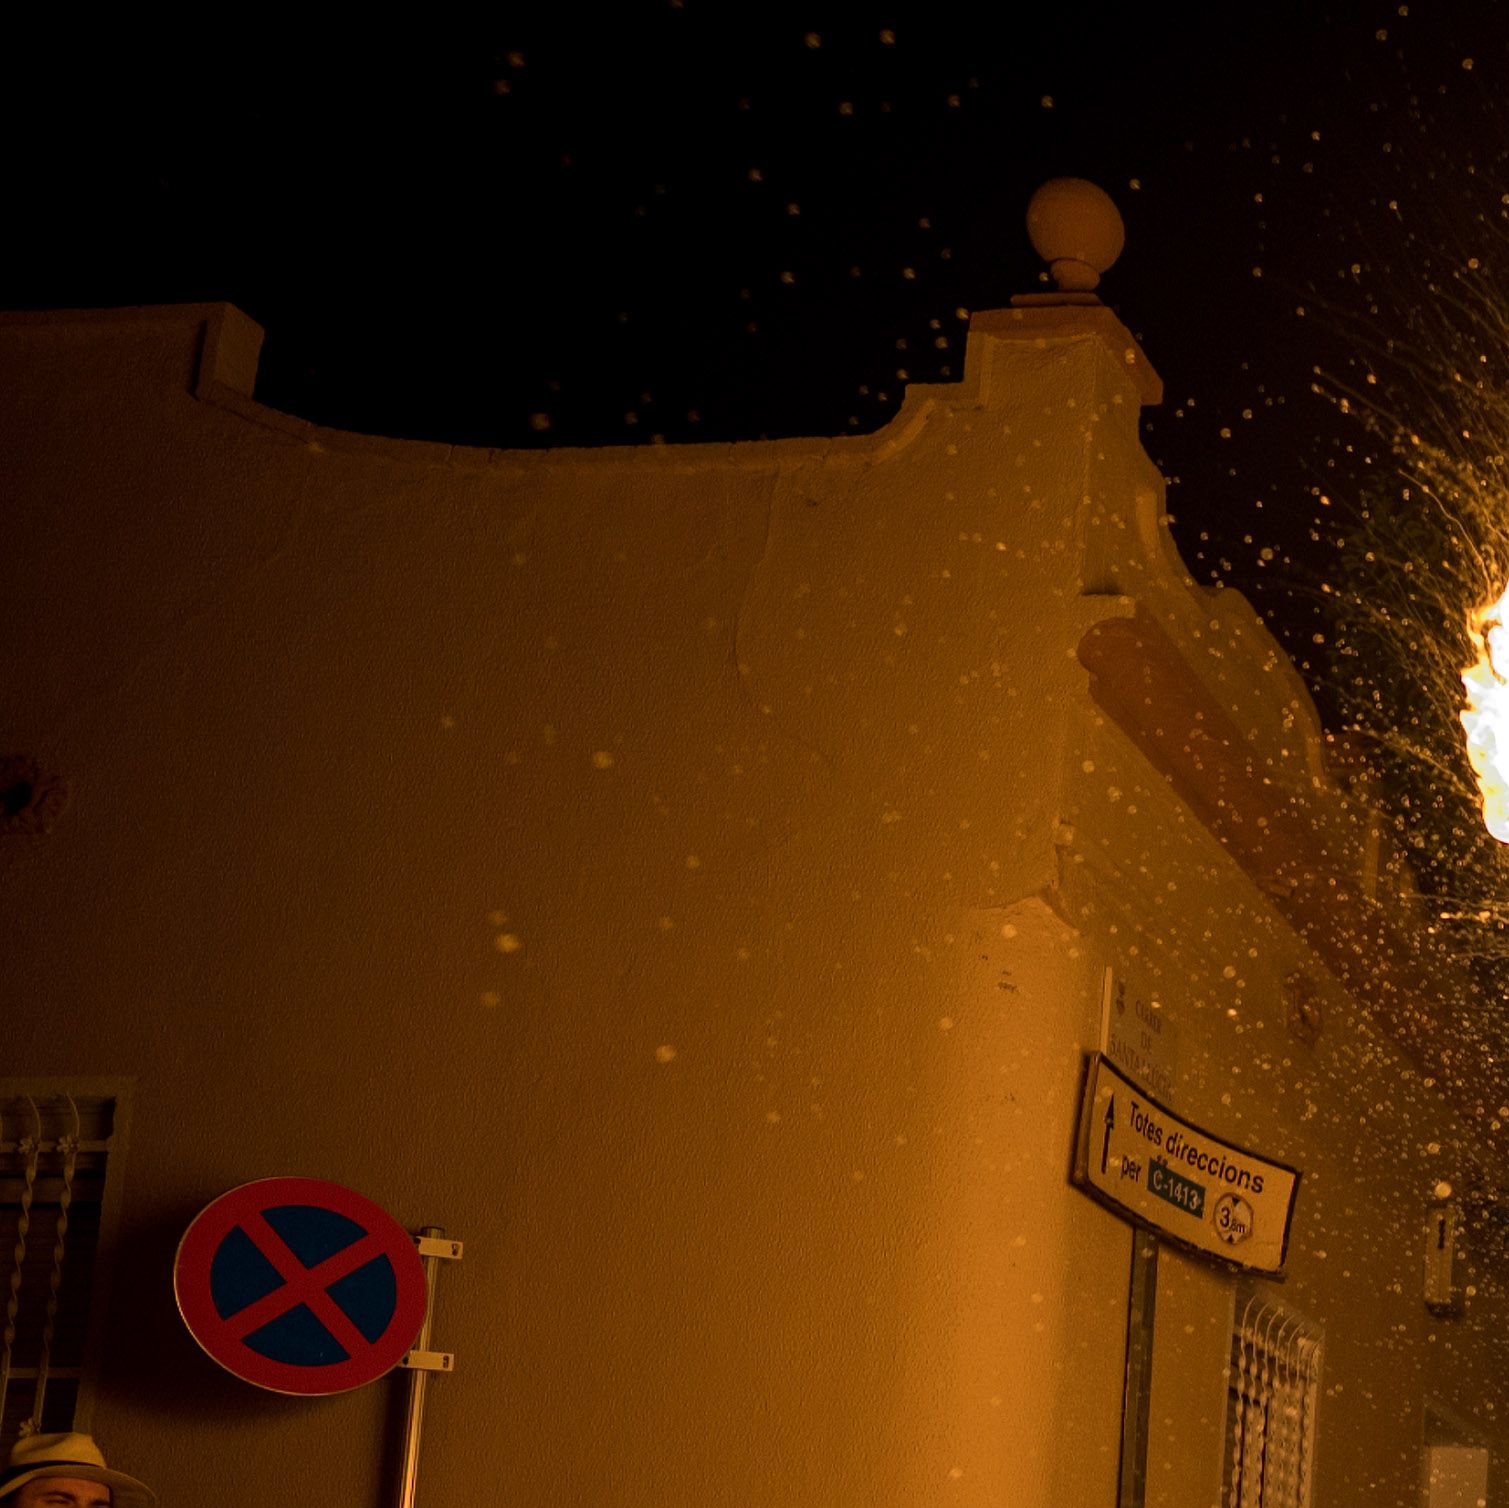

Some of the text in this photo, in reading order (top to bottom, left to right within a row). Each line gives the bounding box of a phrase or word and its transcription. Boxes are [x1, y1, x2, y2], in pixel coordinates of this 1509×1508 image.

[1121, 1156, 1199, 1210] per C-1413
[1130, 1101, 1265, 1193] Totes direccions
